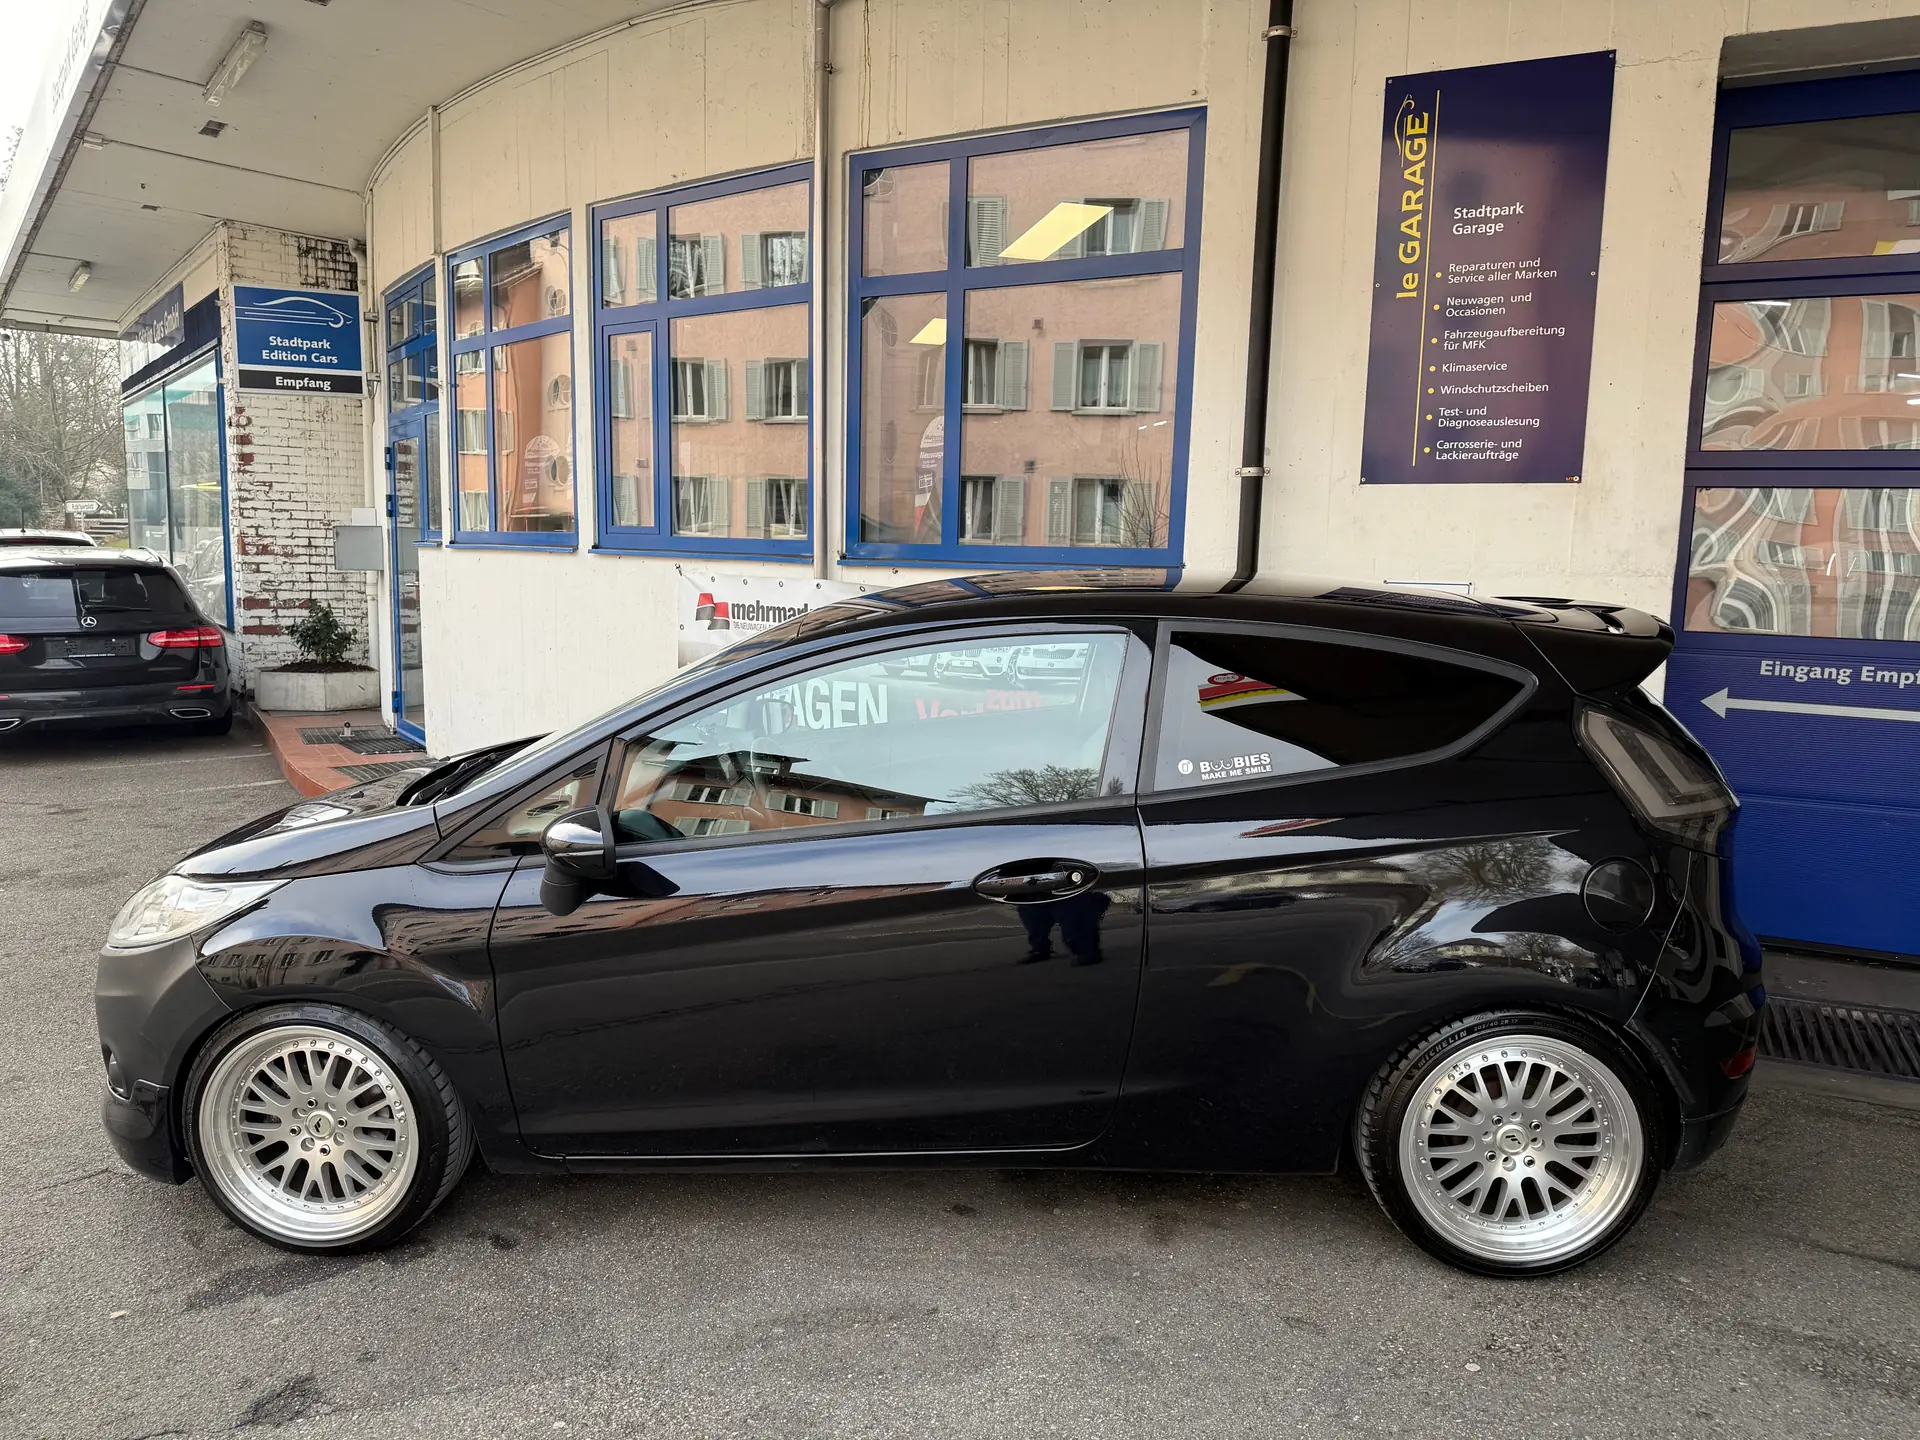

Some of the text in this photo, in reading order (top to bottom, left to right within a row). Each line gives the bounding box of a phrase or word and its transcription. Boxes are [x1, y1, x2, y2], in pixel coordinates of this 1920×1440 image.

[1396, 111, 1429, 299] le GARAGE
[1453, 202, 1525, 219] Stadtpark
[1452, 222, 1504, 235] Garage
[1449, 257, 1540, 274] Reparaturen und
[1448, 269, 1557, 284] Service aller Marken
[1446, 292, 1532, 307] Neuwagen und
[1446, 306, 1506, 317] Occasionen
[1444, 326, 1565, 340] Fahrzeugaufbereitung
[269, 335, 331, 349] Stadtpark
[1444, 340, 1486, 351] für MFK
[262, 350, 338, 364] Edition Cars
[1442, 362, 1508, 373] Klimaservice
[275, 375, 332, 391] Empfang
[1440, 383, 1549, 395] Windschutzscheiben
[1439, 406, 1487, 417] Test- und
[1438, 416, 1540, 429] Diagnoseauslesung
[1436, 438, 1522, 449] Carrosserie- und
[1436, 450, 1519, 461] Lackieraufträge
[1760, 660, 1852, 685] Eingang
[757, 678, 888, 730] AGEN
[1201, 764, 1272, 781] MAKE ME SMILE
[1417, 1029, 1468, 1069] MICHELIN
